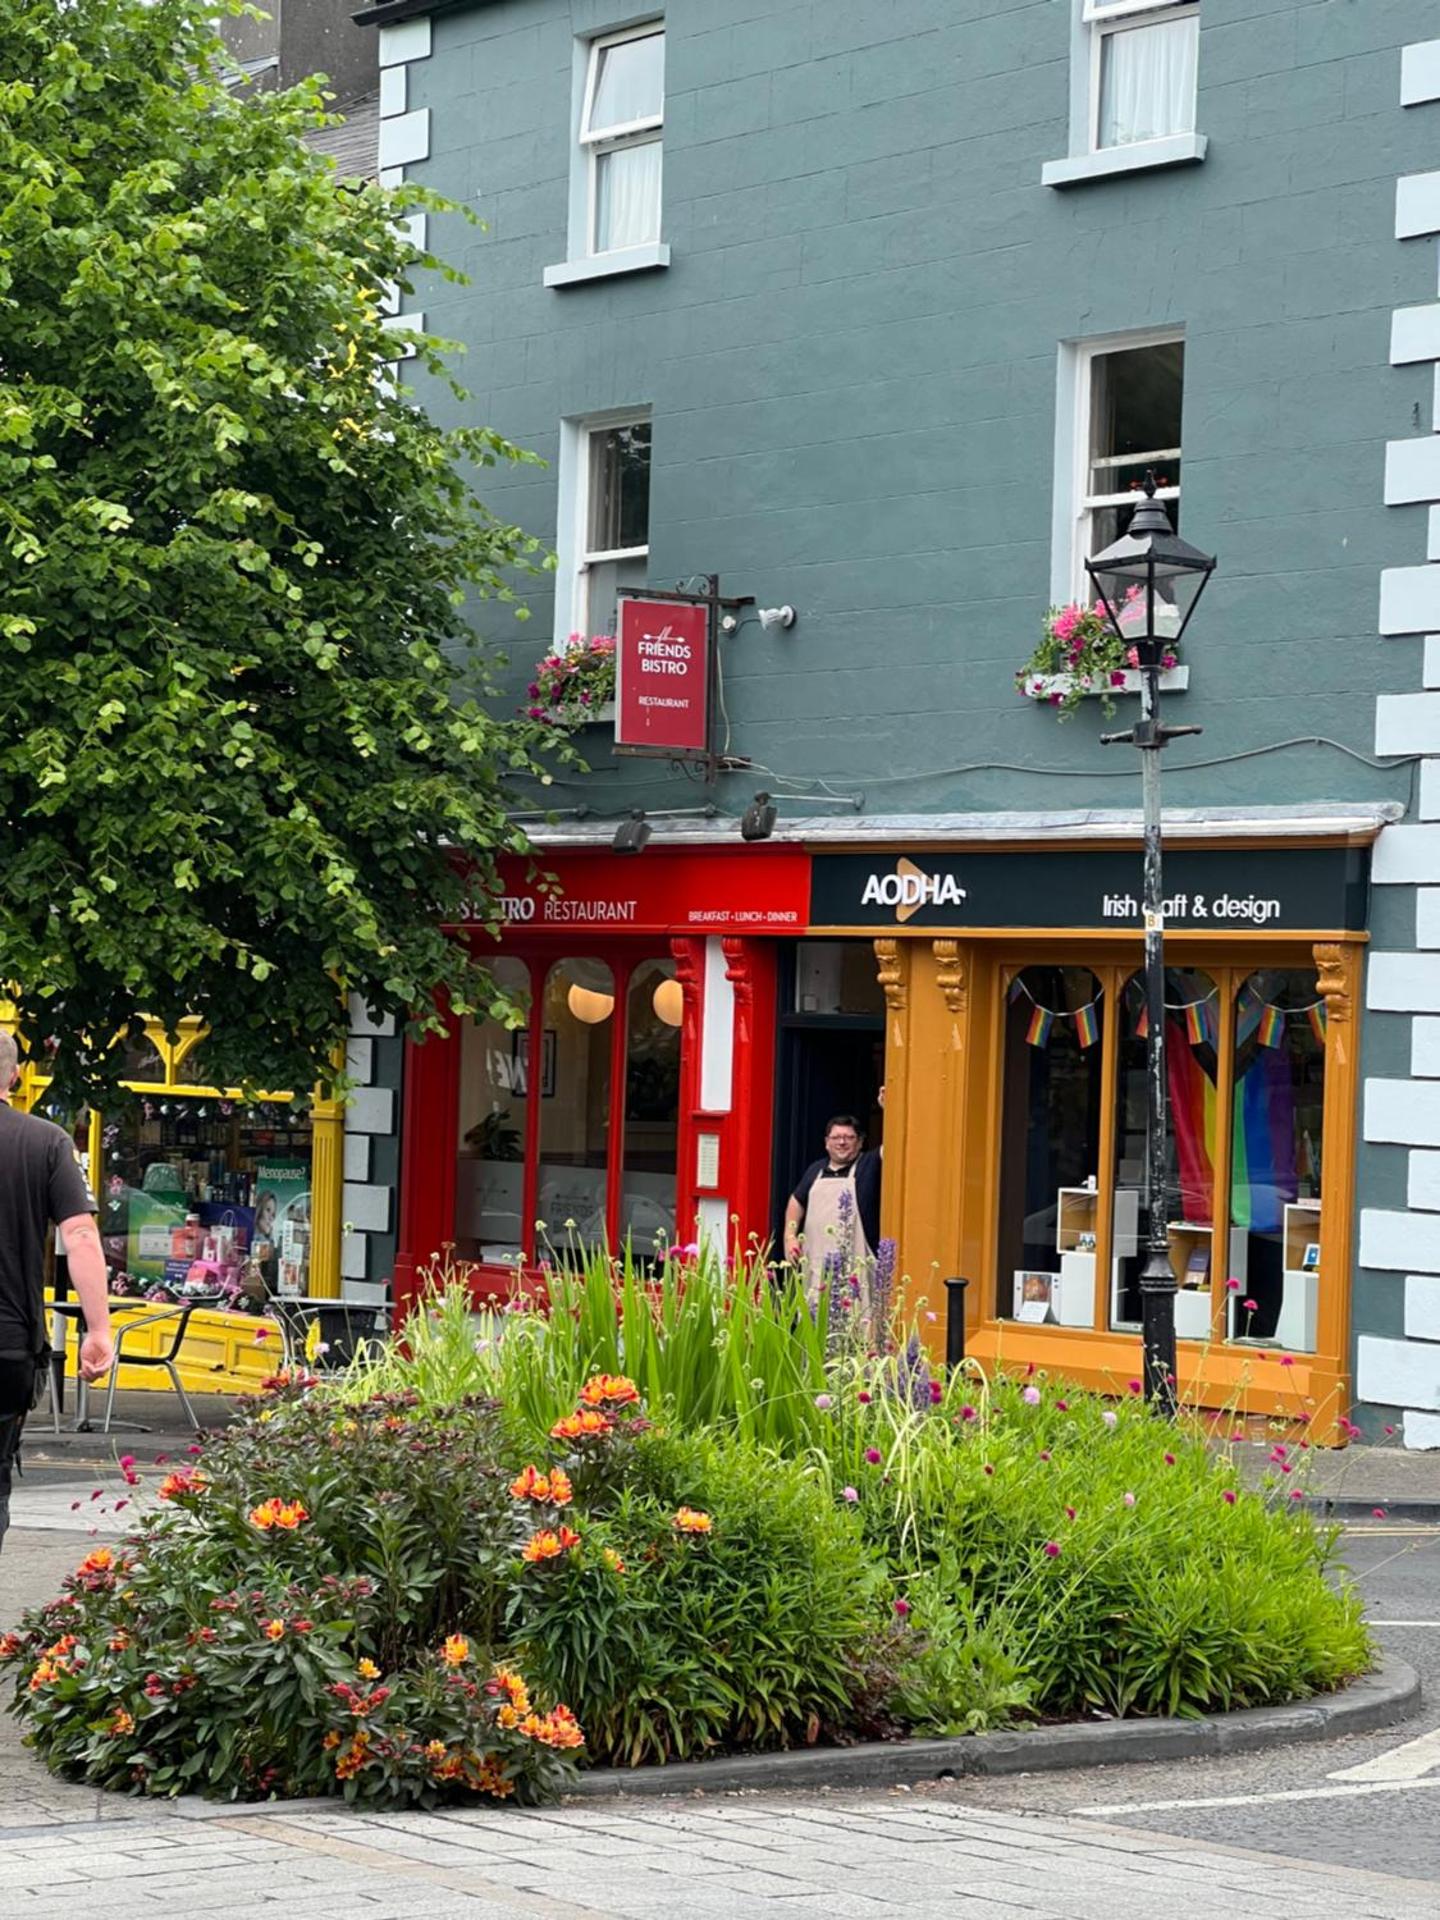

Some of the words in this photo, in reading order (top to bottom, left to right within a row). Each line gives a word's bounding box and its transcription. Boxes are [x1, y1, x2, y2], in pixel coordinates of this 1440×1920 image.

[638, 641, 692, 659] FRIENDS
[641, 658, 688, 675] BISTRO
[638, 696, 689, 708] RESTAURANT
[861, 874, 967, 905] AODHA
[543, 901, 637, 920] RESTAURANT
[688, 911, 730, 922] BREAKFAST
[735, 911, 762, 922] LUNCH
[767, 911, 798, 922] DINNER
[1102, 894, 1137, 917] Irish
[1191, 895, 1208, 918] &
[1212, 894, 1280, 924] design
